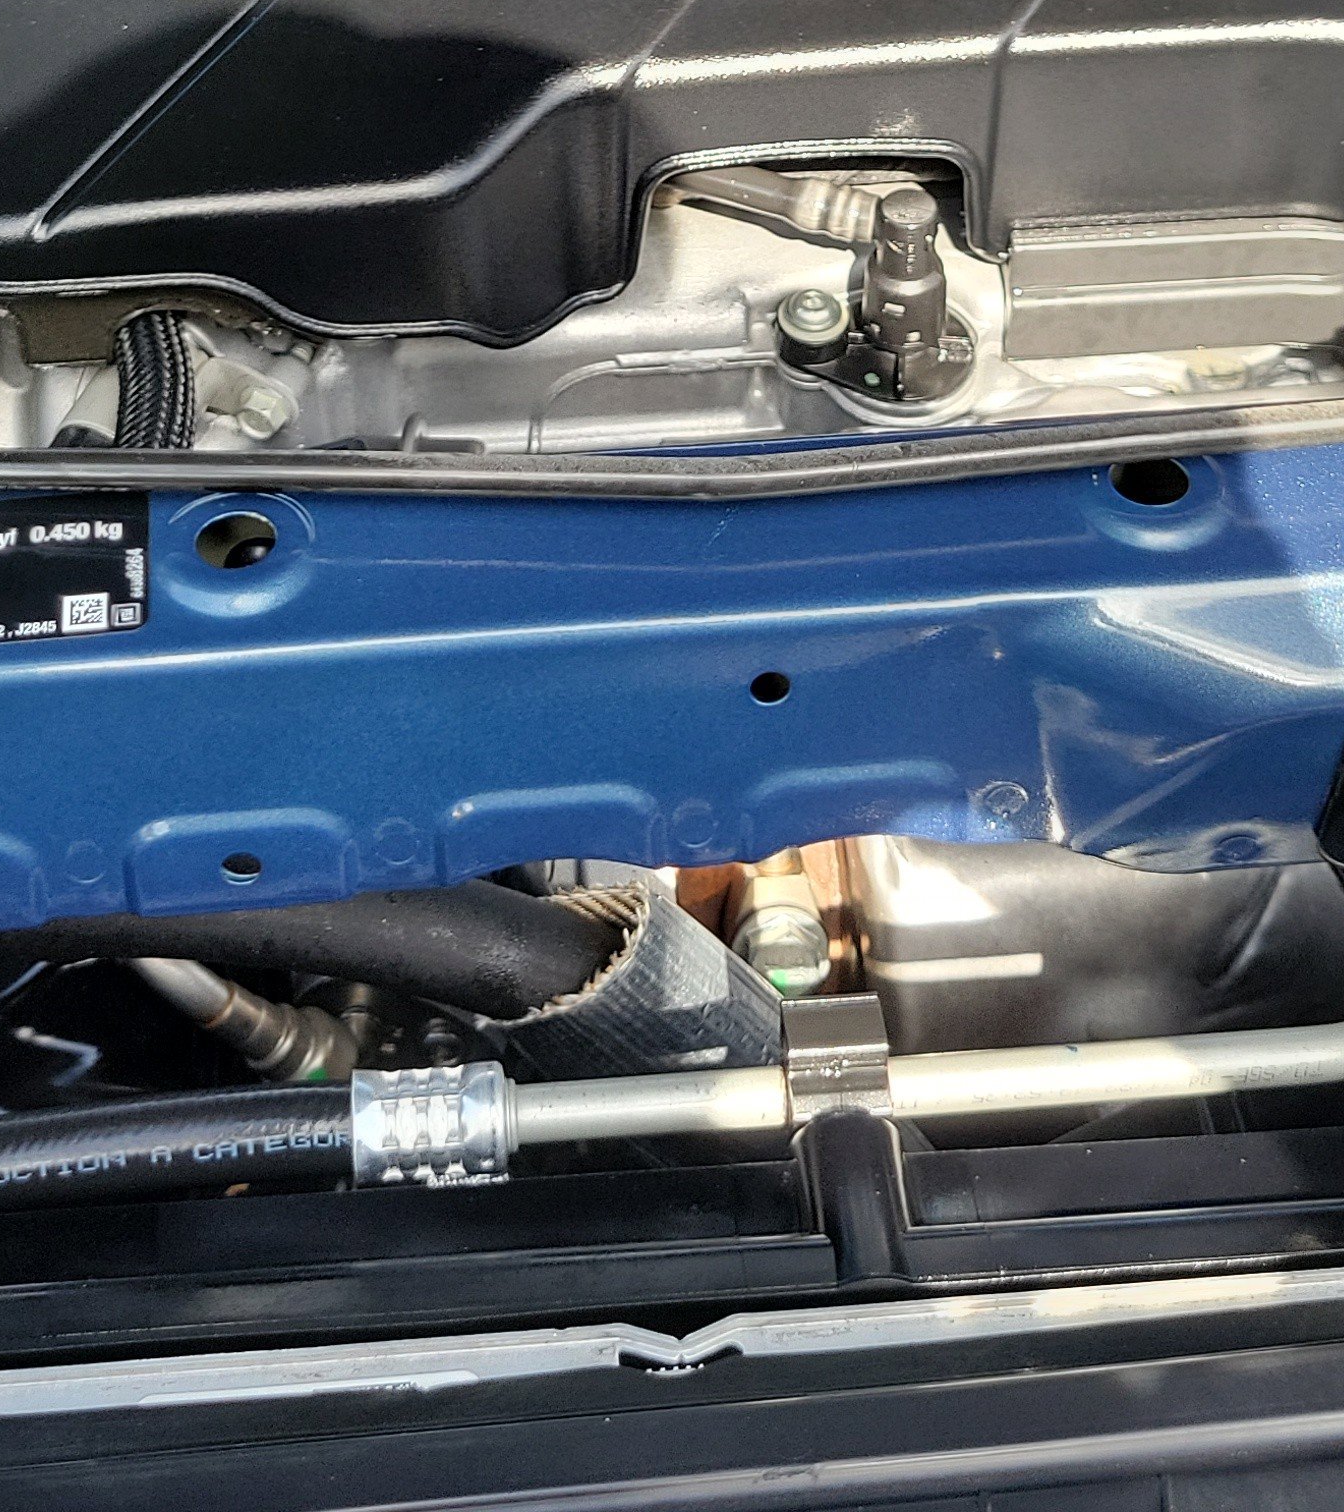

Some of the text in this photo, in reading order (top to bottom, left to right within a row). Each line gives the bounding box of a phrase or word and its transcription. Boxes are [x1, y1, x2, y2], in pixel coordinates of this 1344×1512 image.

[29, 522, 90, 544] 0.450
[94, 520, 123, 542] kg
[15, 620, 57, 636] J2845
[150, 1144, 173, 1164] A
